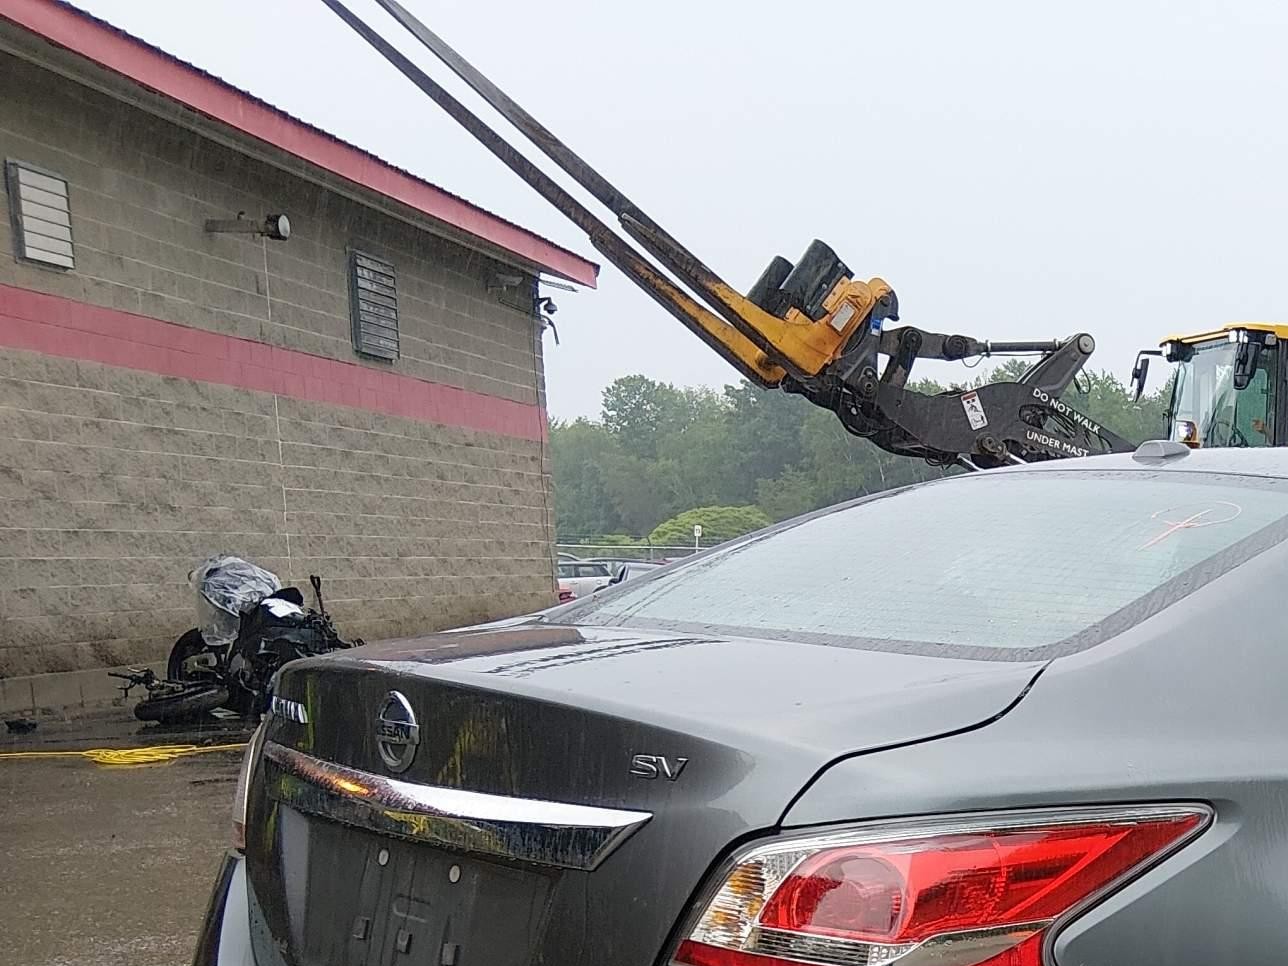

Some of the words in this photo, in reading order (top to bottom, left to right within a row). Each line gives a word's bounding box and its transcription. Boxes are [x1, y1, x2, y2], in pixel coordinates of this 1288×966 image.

[1032, 388, 1049, 402] DO
[1050, 398, 1073, 416] NOT
[1073, 411, 1101, 434] WALK
[1026, 430, 1061, 449] UNDER
[1062, 442, 1090, 457] MAST
[630, 754, 689, 781] SV
